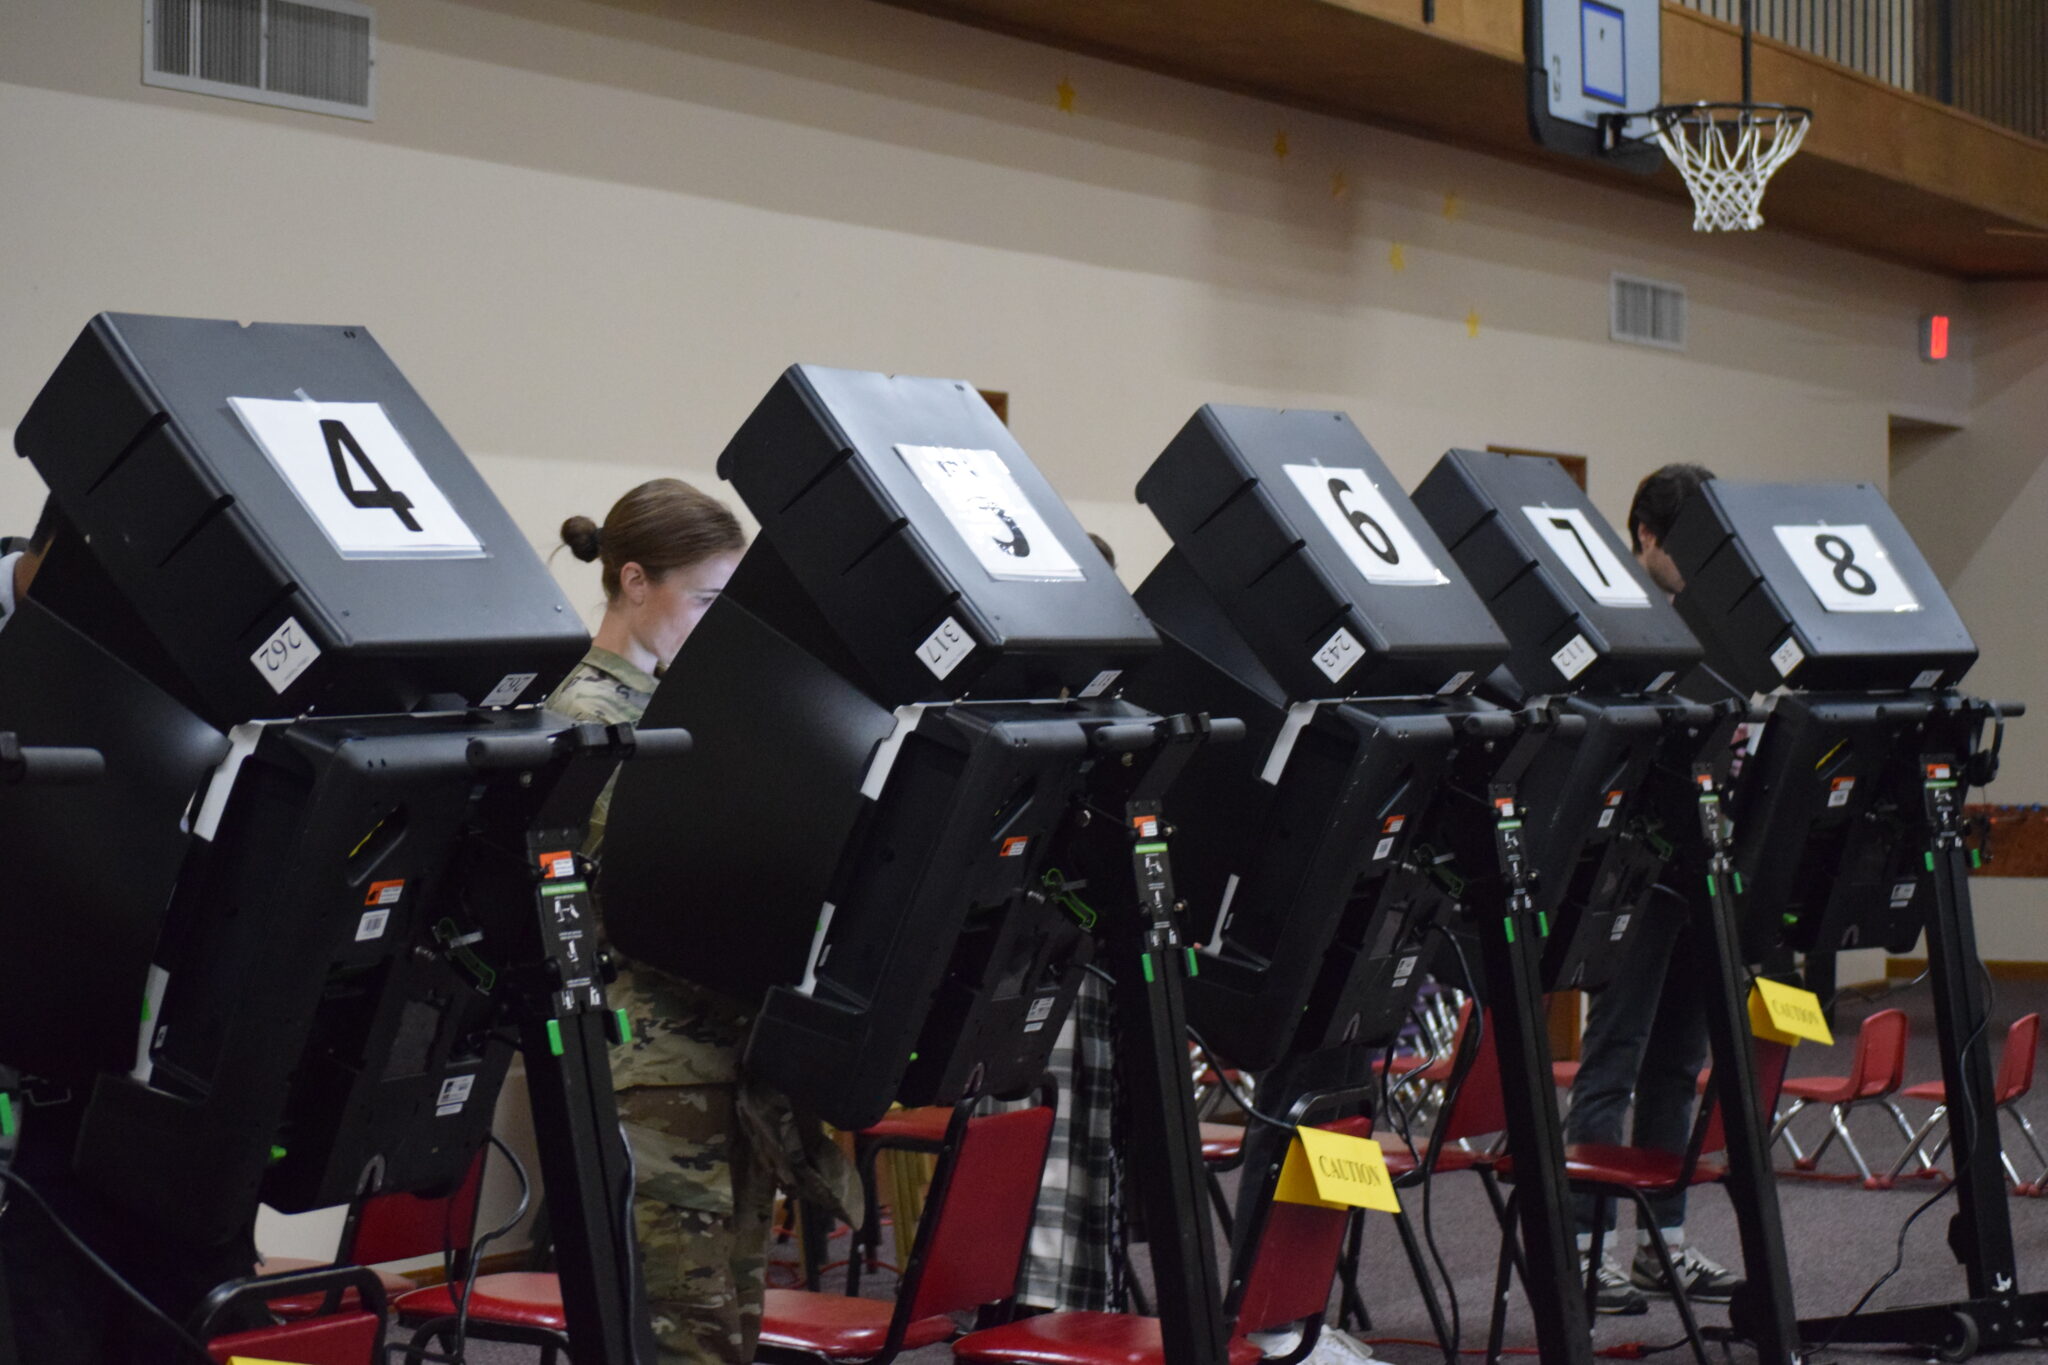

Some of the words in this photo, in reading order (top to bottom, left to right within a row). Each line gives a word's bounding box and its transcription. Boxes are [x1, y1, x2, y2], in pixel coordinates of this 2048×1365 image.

[319, 419, 423, 532] 4
[1327, 477, 1400, 565] 6
[1547, 517, 1611, 588] 7
[1814, 533, 1877, 596] 8
[259, 625, 302, 671] 262
[926, 624, 960, 664] 317
[1320, 634, 1350, 667] 243
[1318, 1154, 1382, 1187] CAUTION
